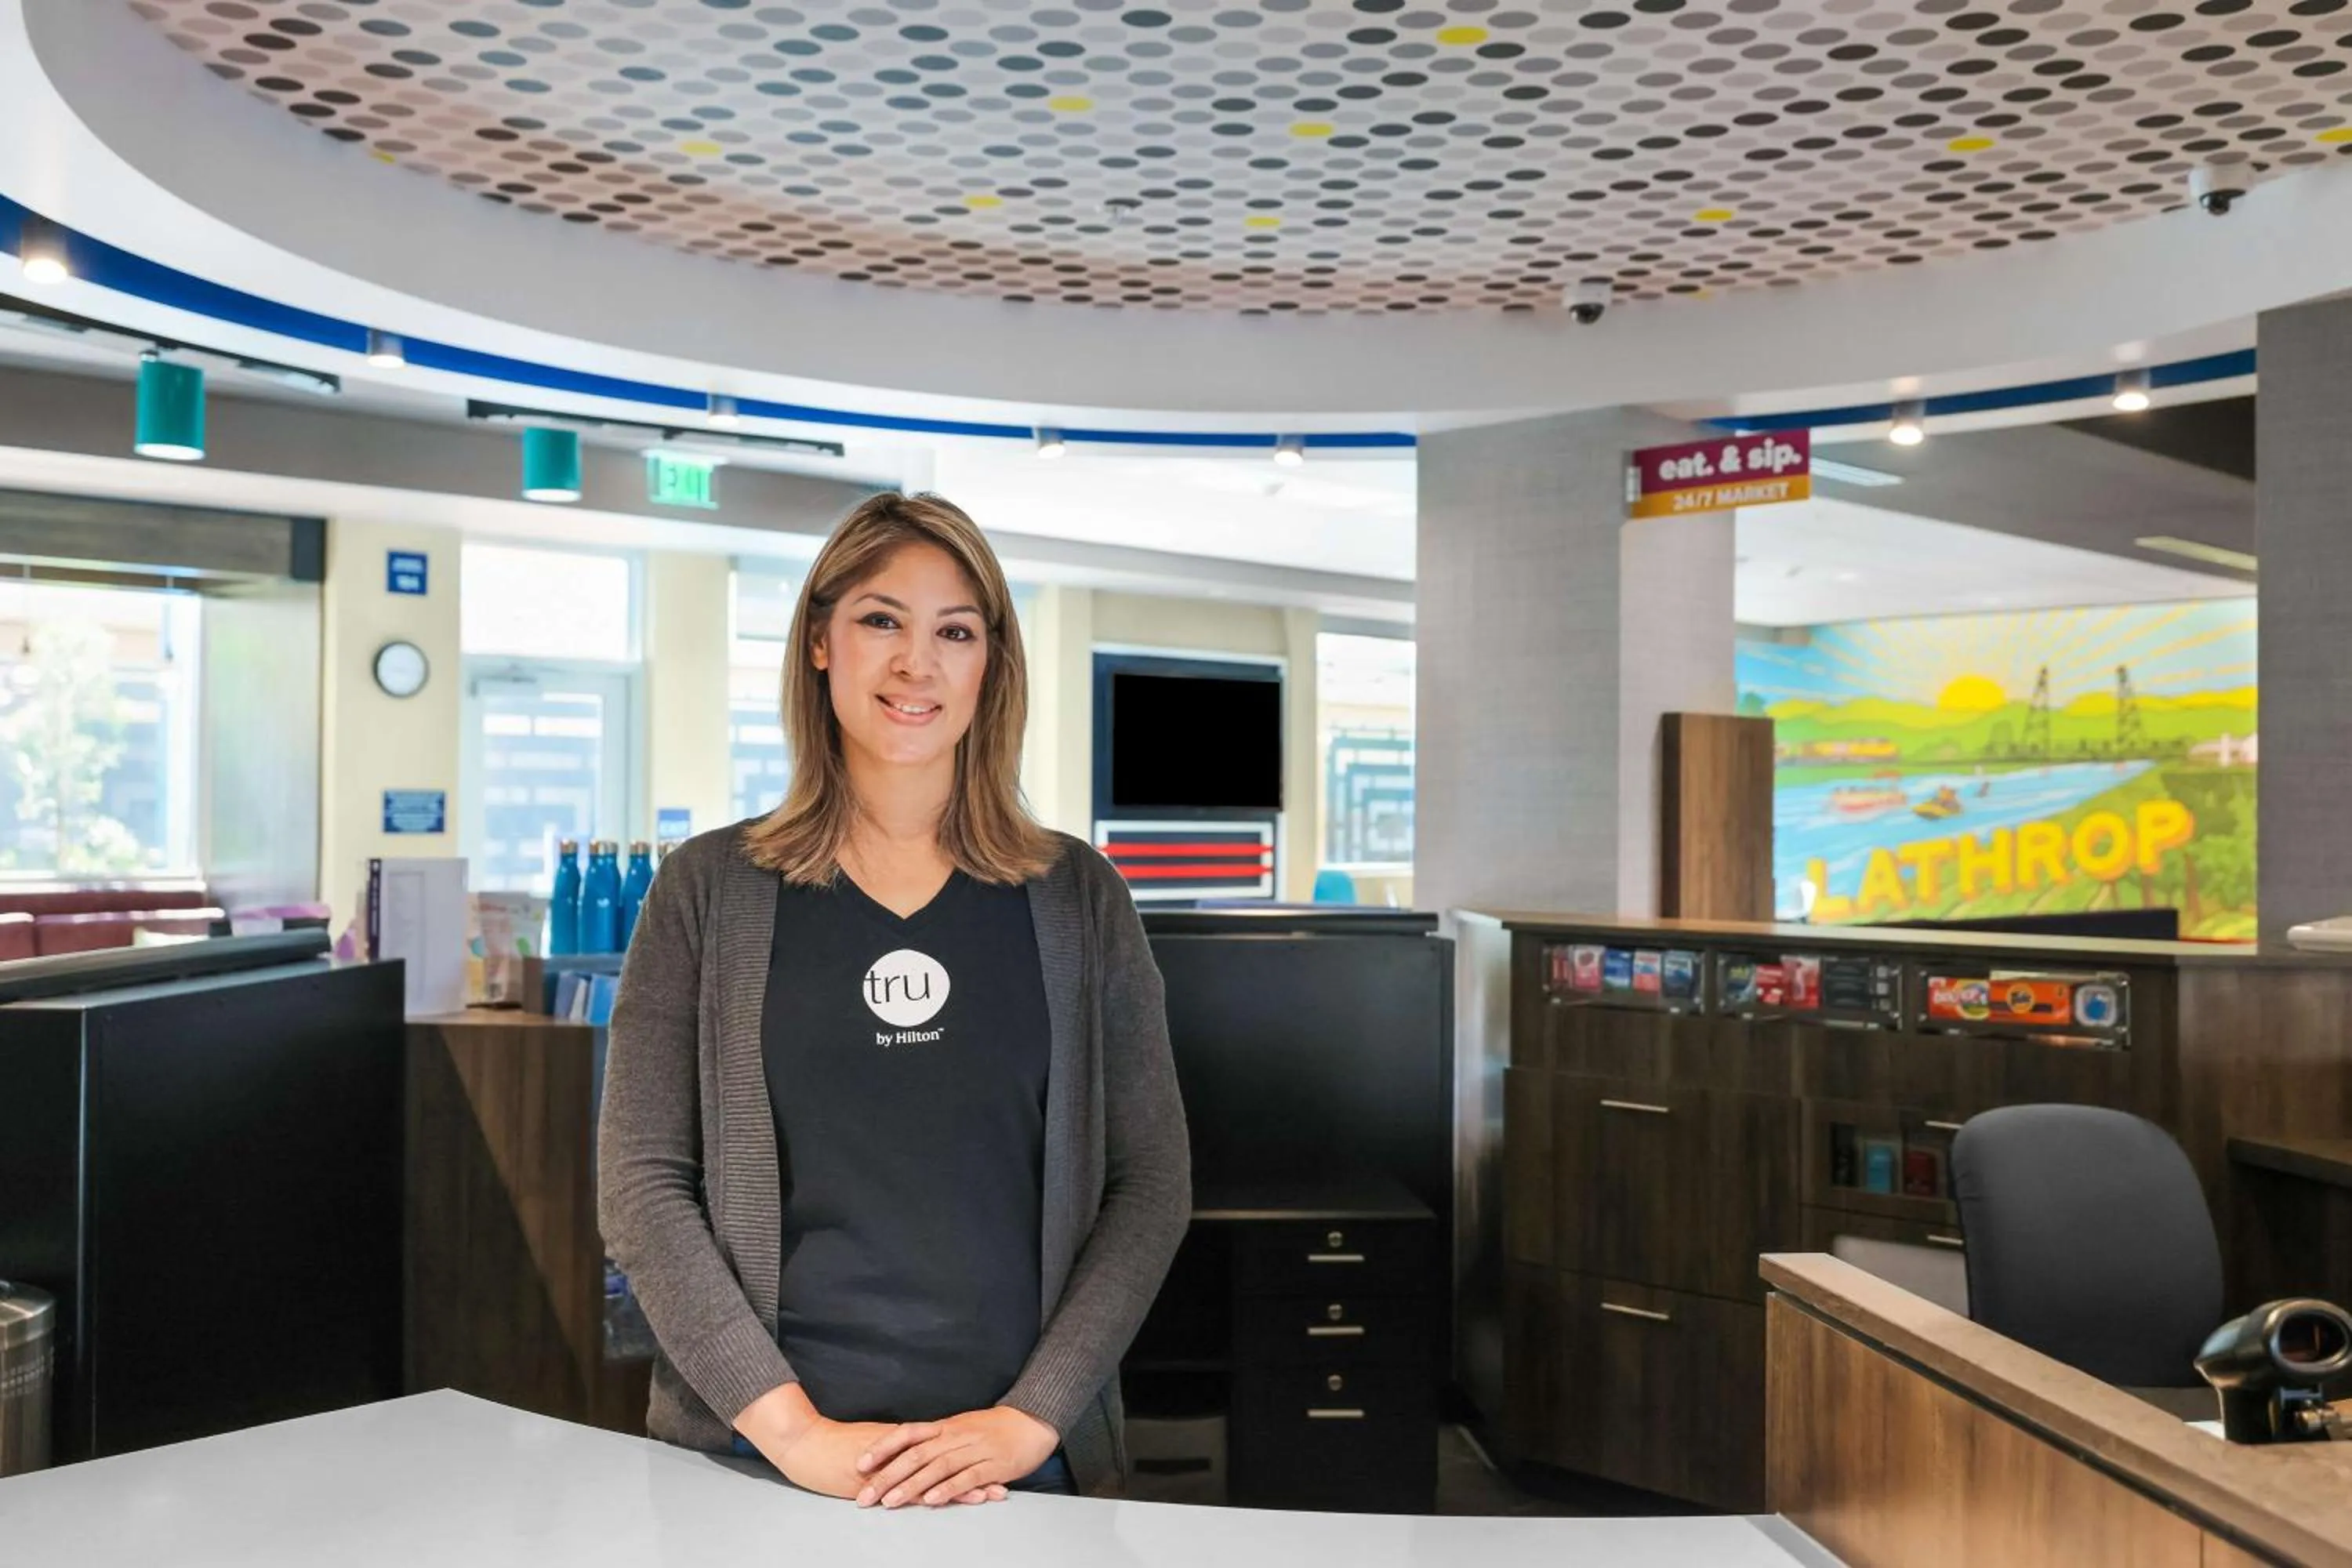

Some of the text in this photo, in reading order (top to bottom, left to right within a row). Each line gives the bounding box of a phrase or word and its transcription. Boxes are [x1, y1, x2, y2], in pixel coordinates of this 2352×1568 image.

[1659, 437, 1802, 481] eat. & sip.
[1808, 800, 2194, 924] LATHROP
[864, 970, 931, 1004] tru
[876, 1032, 893, 1047] by
